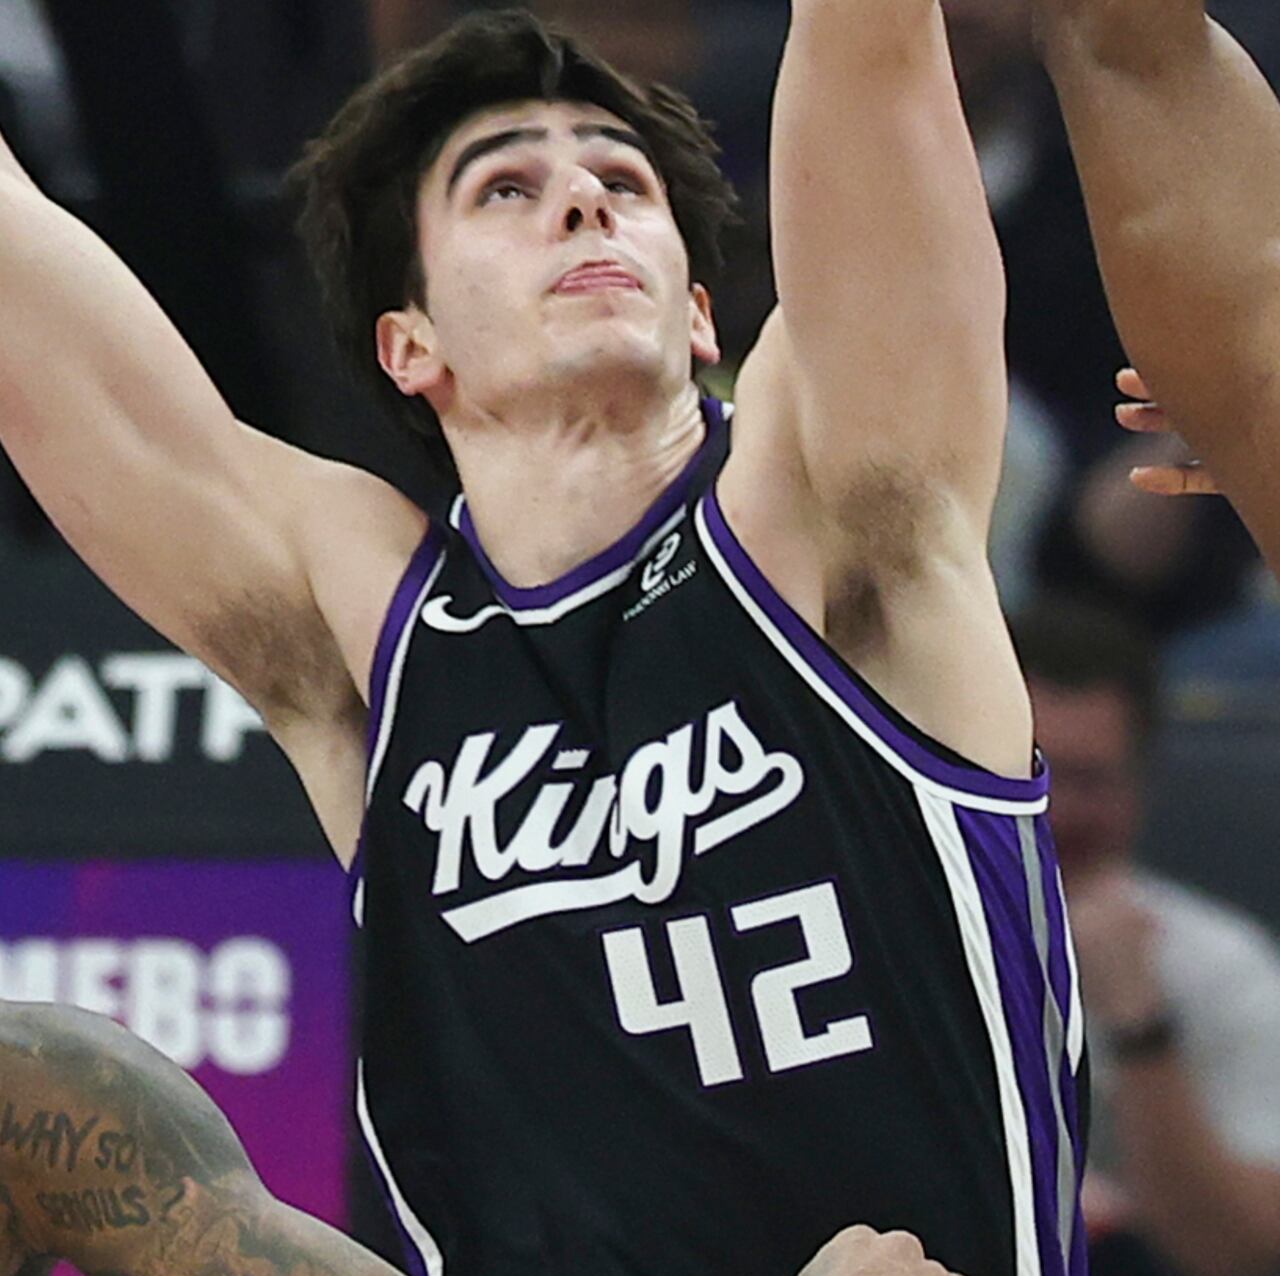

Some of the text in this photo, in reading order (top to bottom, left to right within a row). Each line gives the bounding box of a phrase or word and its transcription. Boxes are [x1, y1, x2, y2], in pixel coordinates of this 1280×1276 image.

[403, 701, 805, 944] Kings
[601, 880, 874, 1088] 42
[94, 1130, 138, 1174] SO
